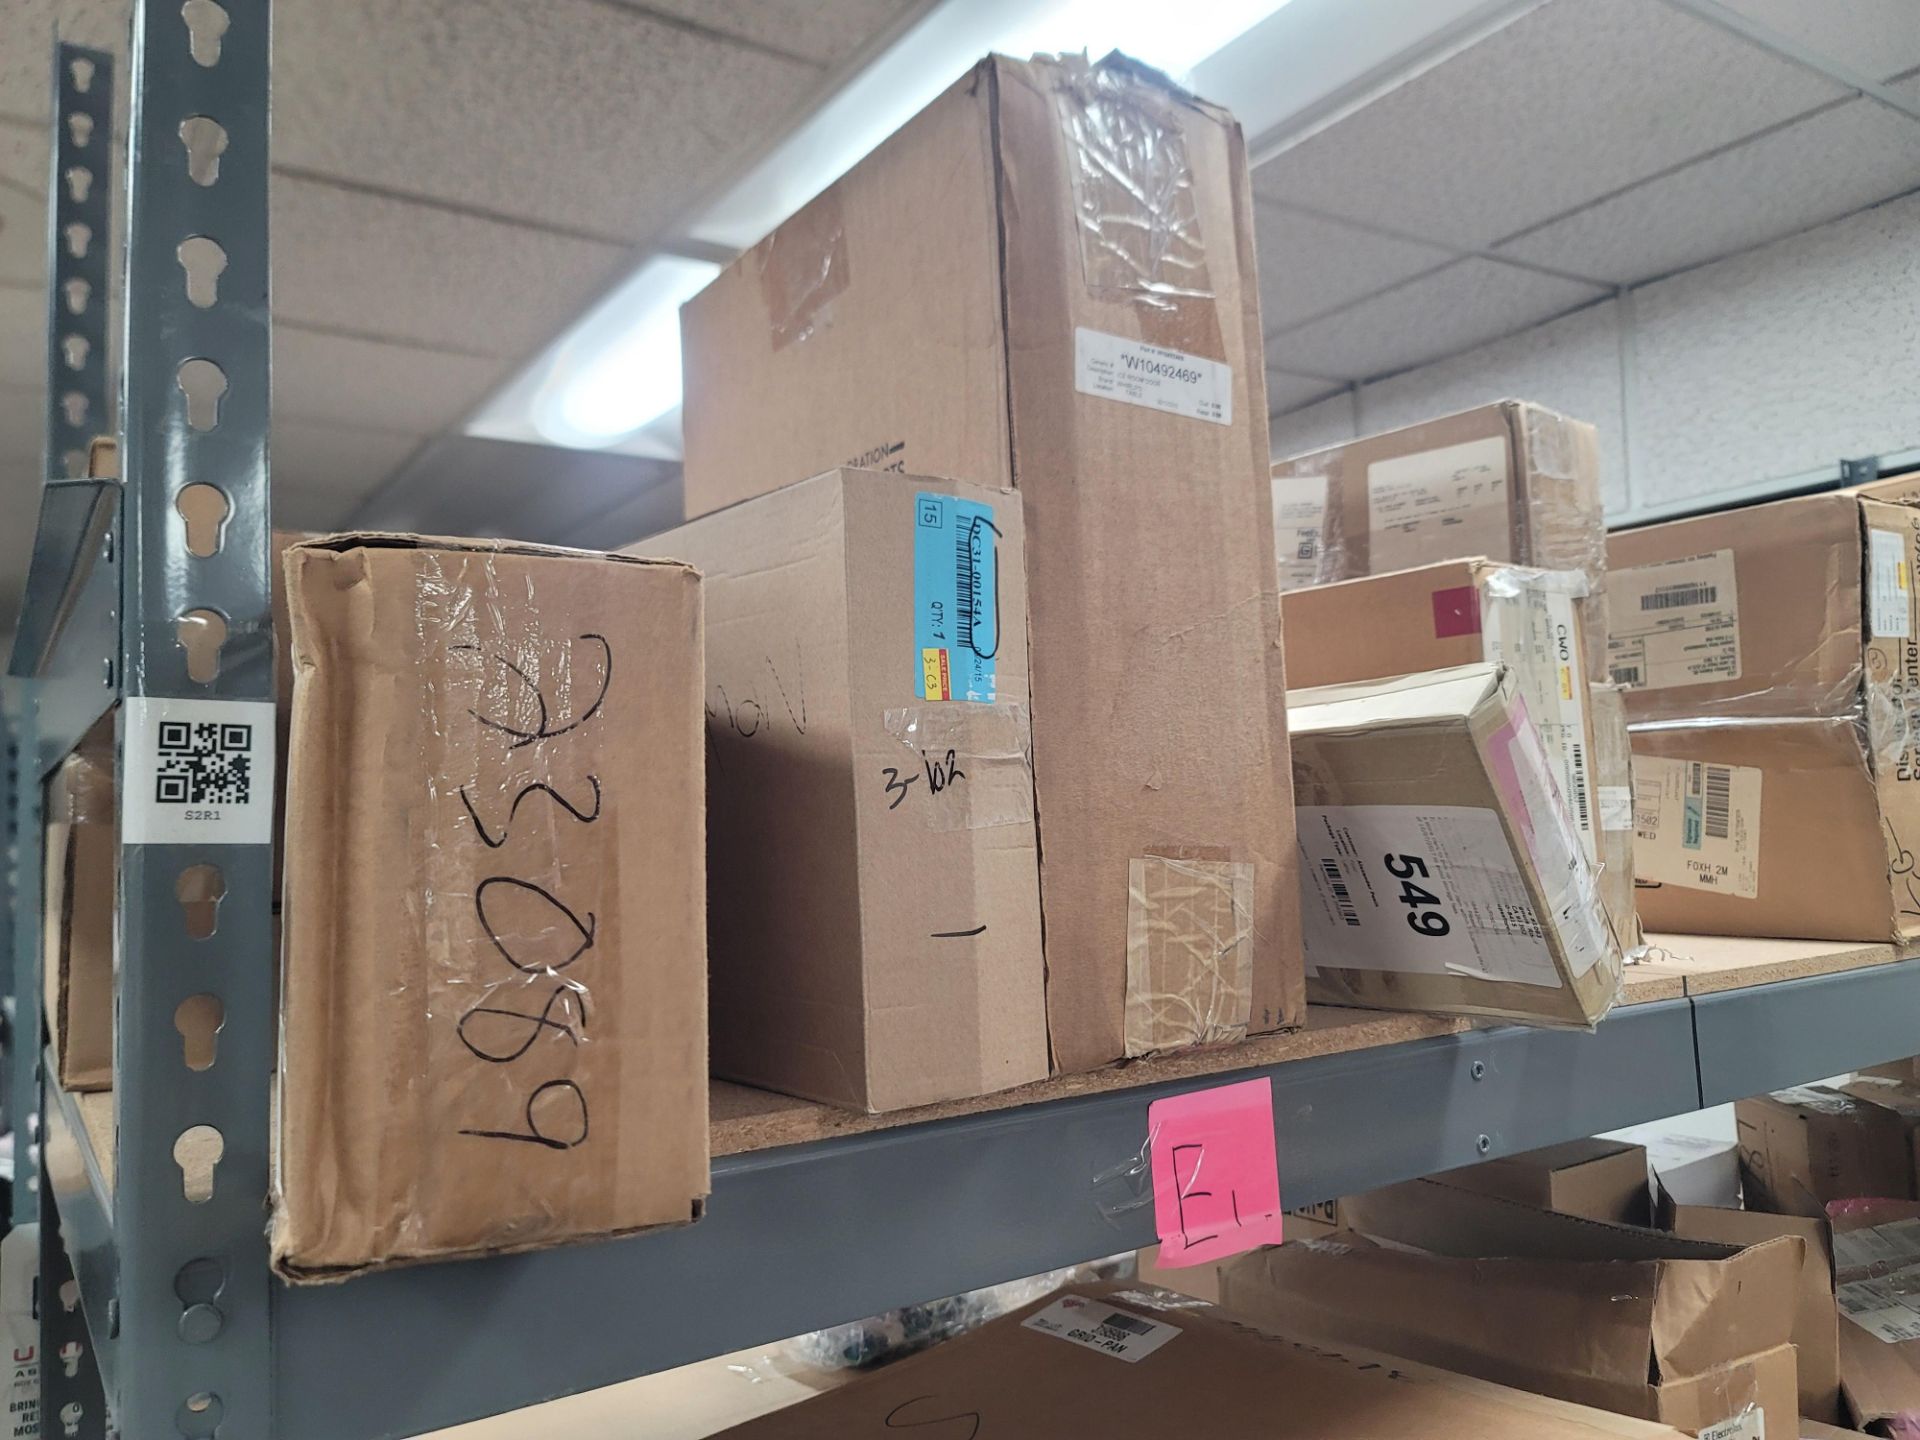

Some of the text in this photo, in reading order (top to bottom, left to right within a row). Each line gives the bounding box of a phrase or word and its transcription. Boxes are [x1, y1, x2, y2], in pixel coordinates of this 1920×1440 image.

[923, 502, 938, 525] 15
[971, 523, 982, 628] DC31-00154A
[183, 809, 222, 822] S2R1
[1383, 853, 1451, 937] 549
